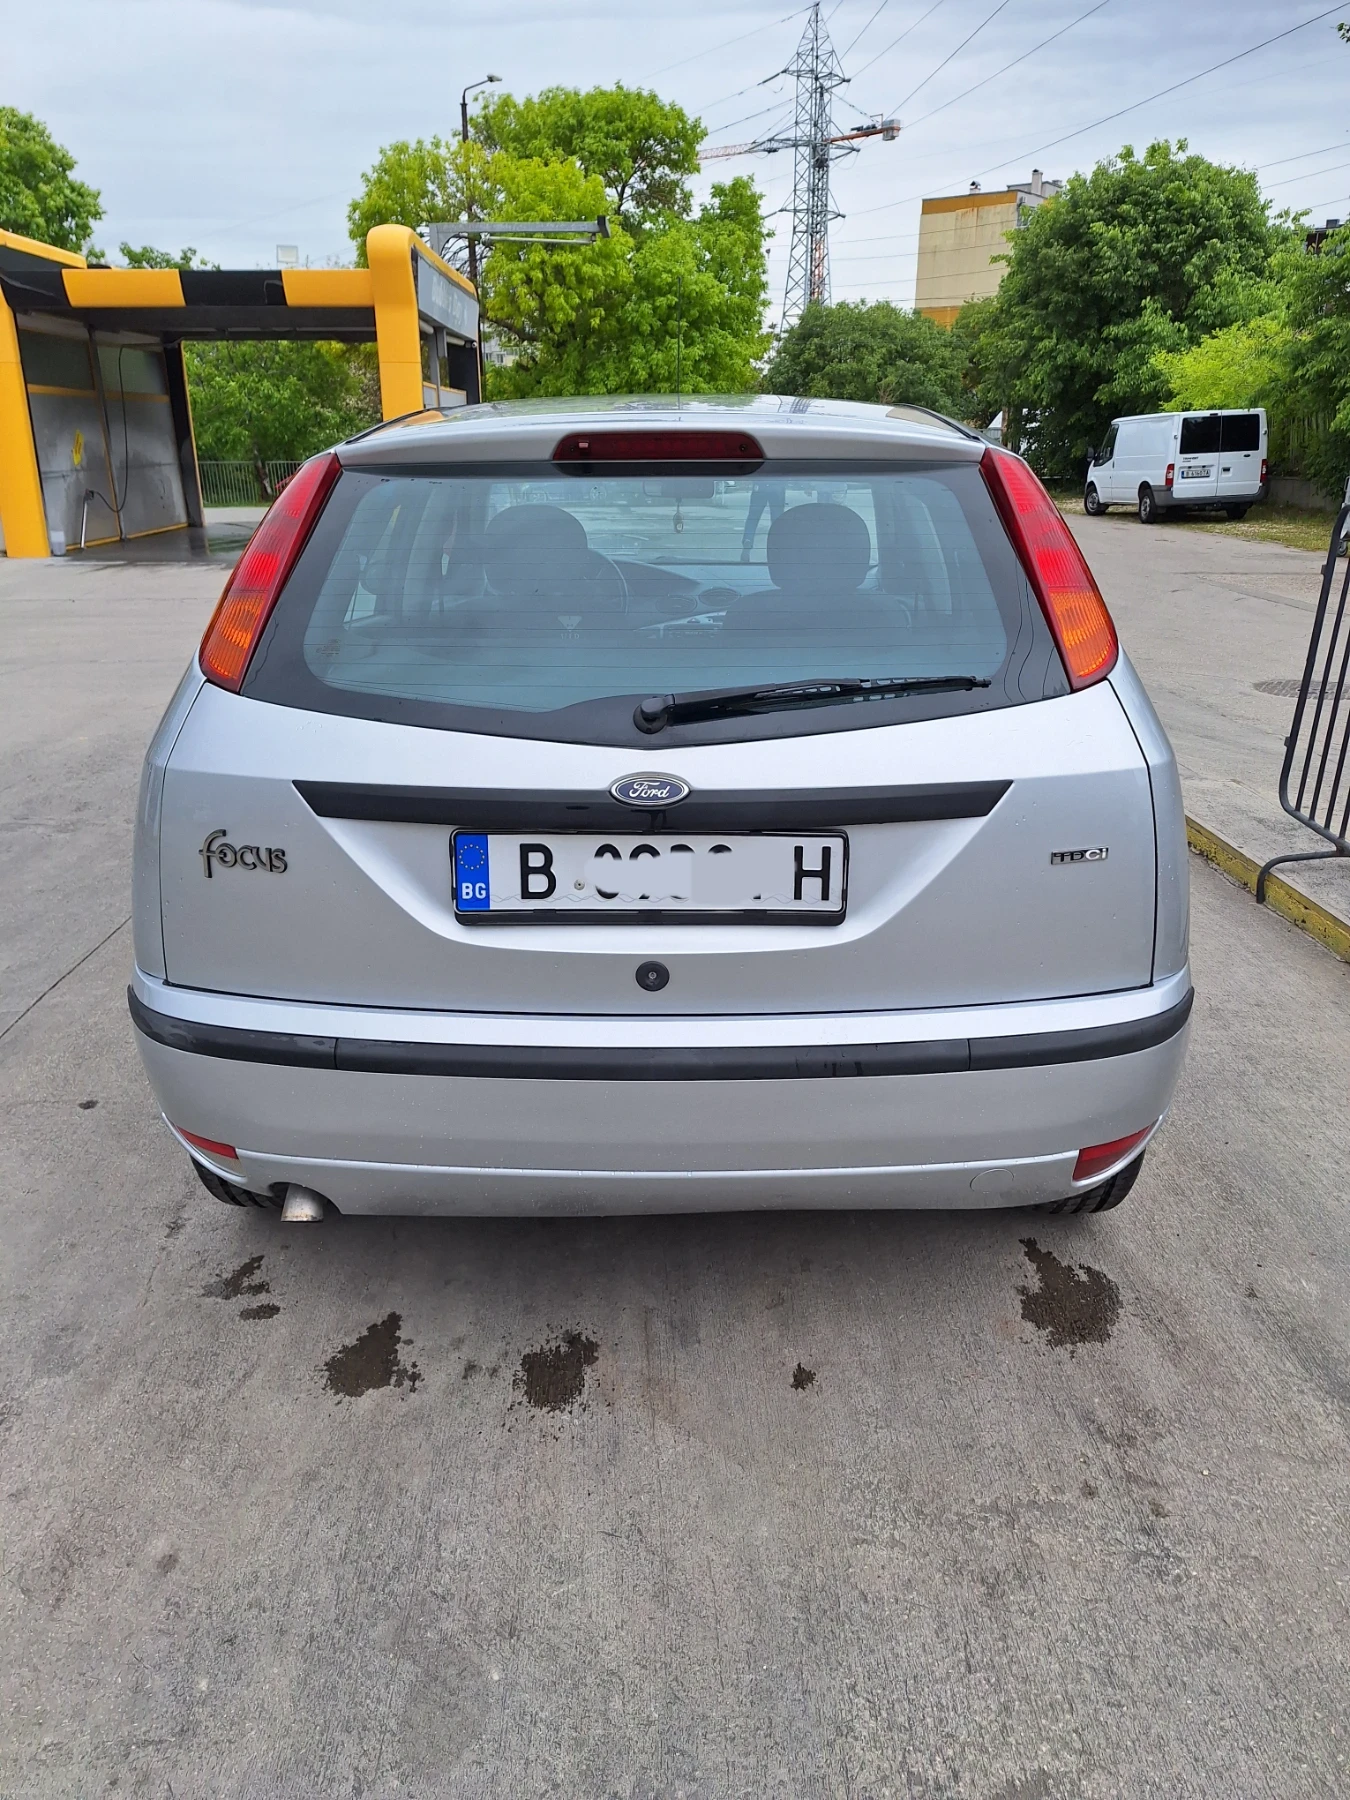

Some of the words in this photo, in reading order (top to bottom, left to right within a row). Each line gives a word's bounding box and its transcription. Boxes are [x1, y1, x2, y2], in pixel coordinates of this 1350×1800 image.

[629, 781, 670, 798] Ford
[520, 843, 557, 900] B
[462, 882, 487, 900] BG
